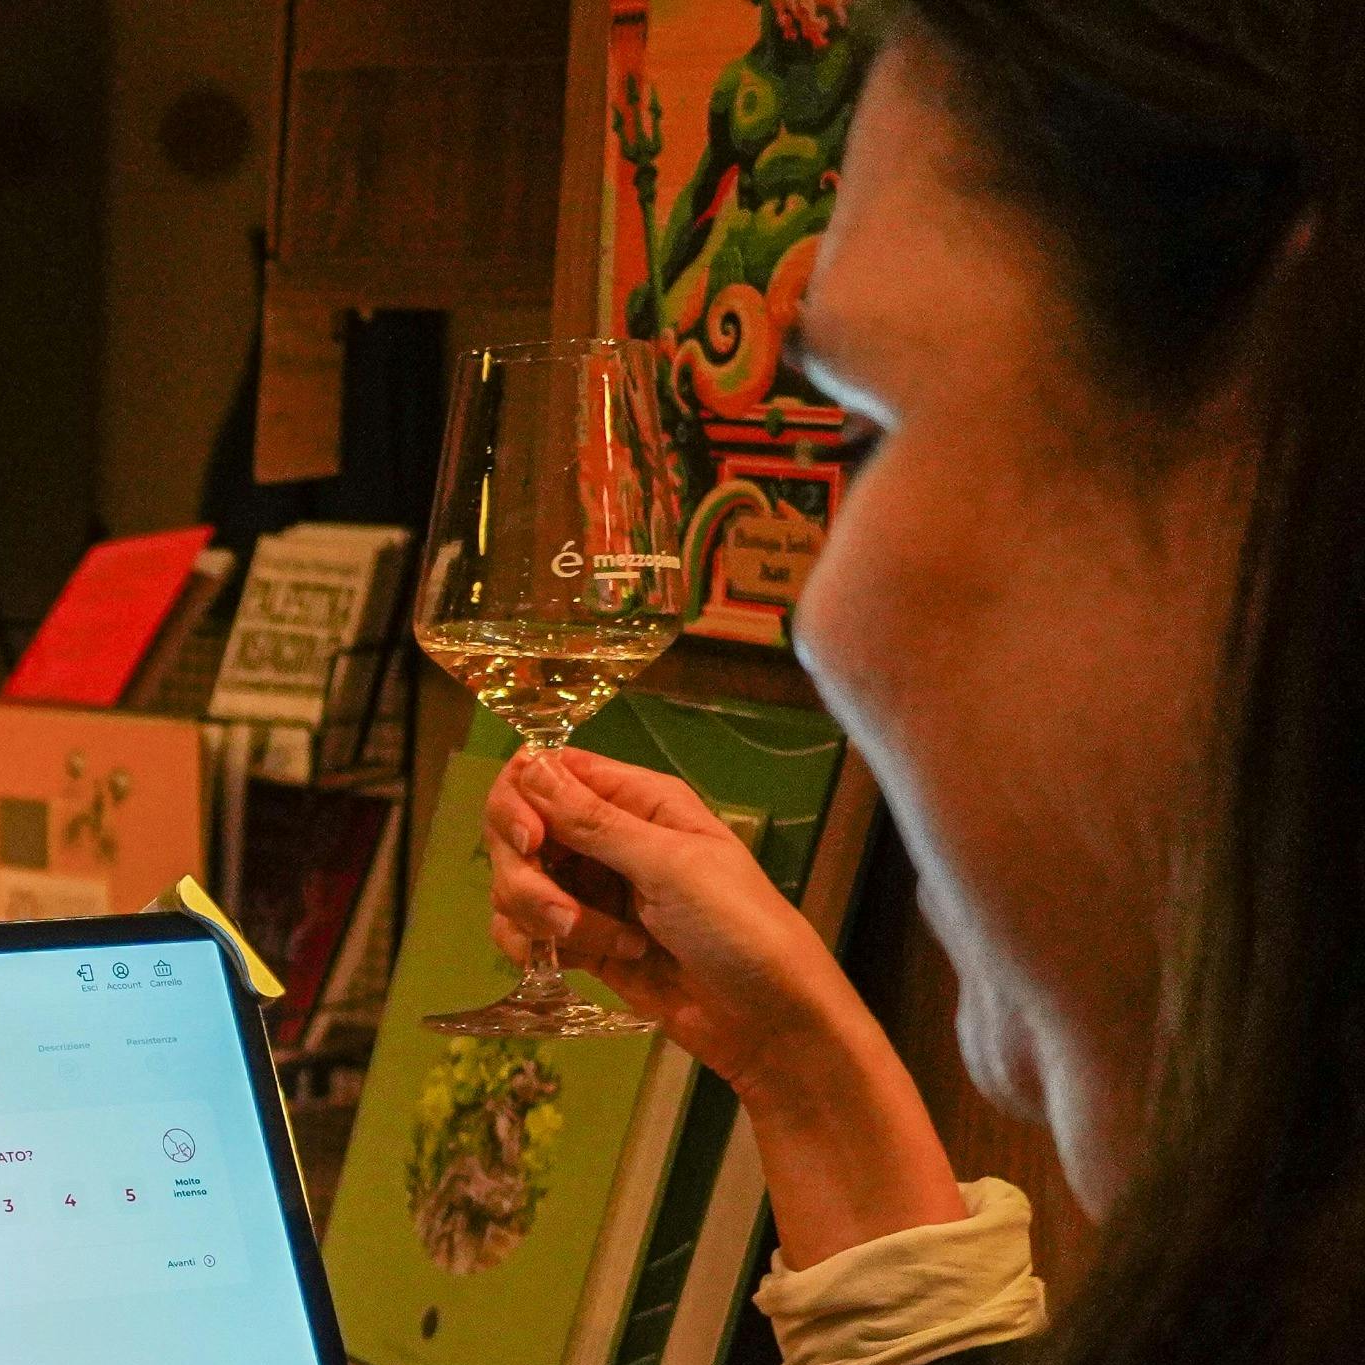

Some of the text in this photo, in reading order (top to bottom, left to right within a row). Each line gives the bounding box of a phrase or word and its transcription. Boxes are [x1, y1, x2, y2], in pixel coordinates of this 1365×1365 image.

[106, 980, 142, 990] Account
[149, 977, 183, 988] Carrello
[81, 984, 98, 993] Esci
[126, 1035, 178, 1046] Persistenza
[38, 1041, 91, 1053] Descrizione
[175, 1177, 201, 1187] Molto
[173, 1187, 207, 1198] intenso
[2, 1199, 14, 1213] 3
[64, 1193, 77, 1207] 4
[125, 1188, 136, 1202] 5
[167, 1258, 196, 1268] Avanti
